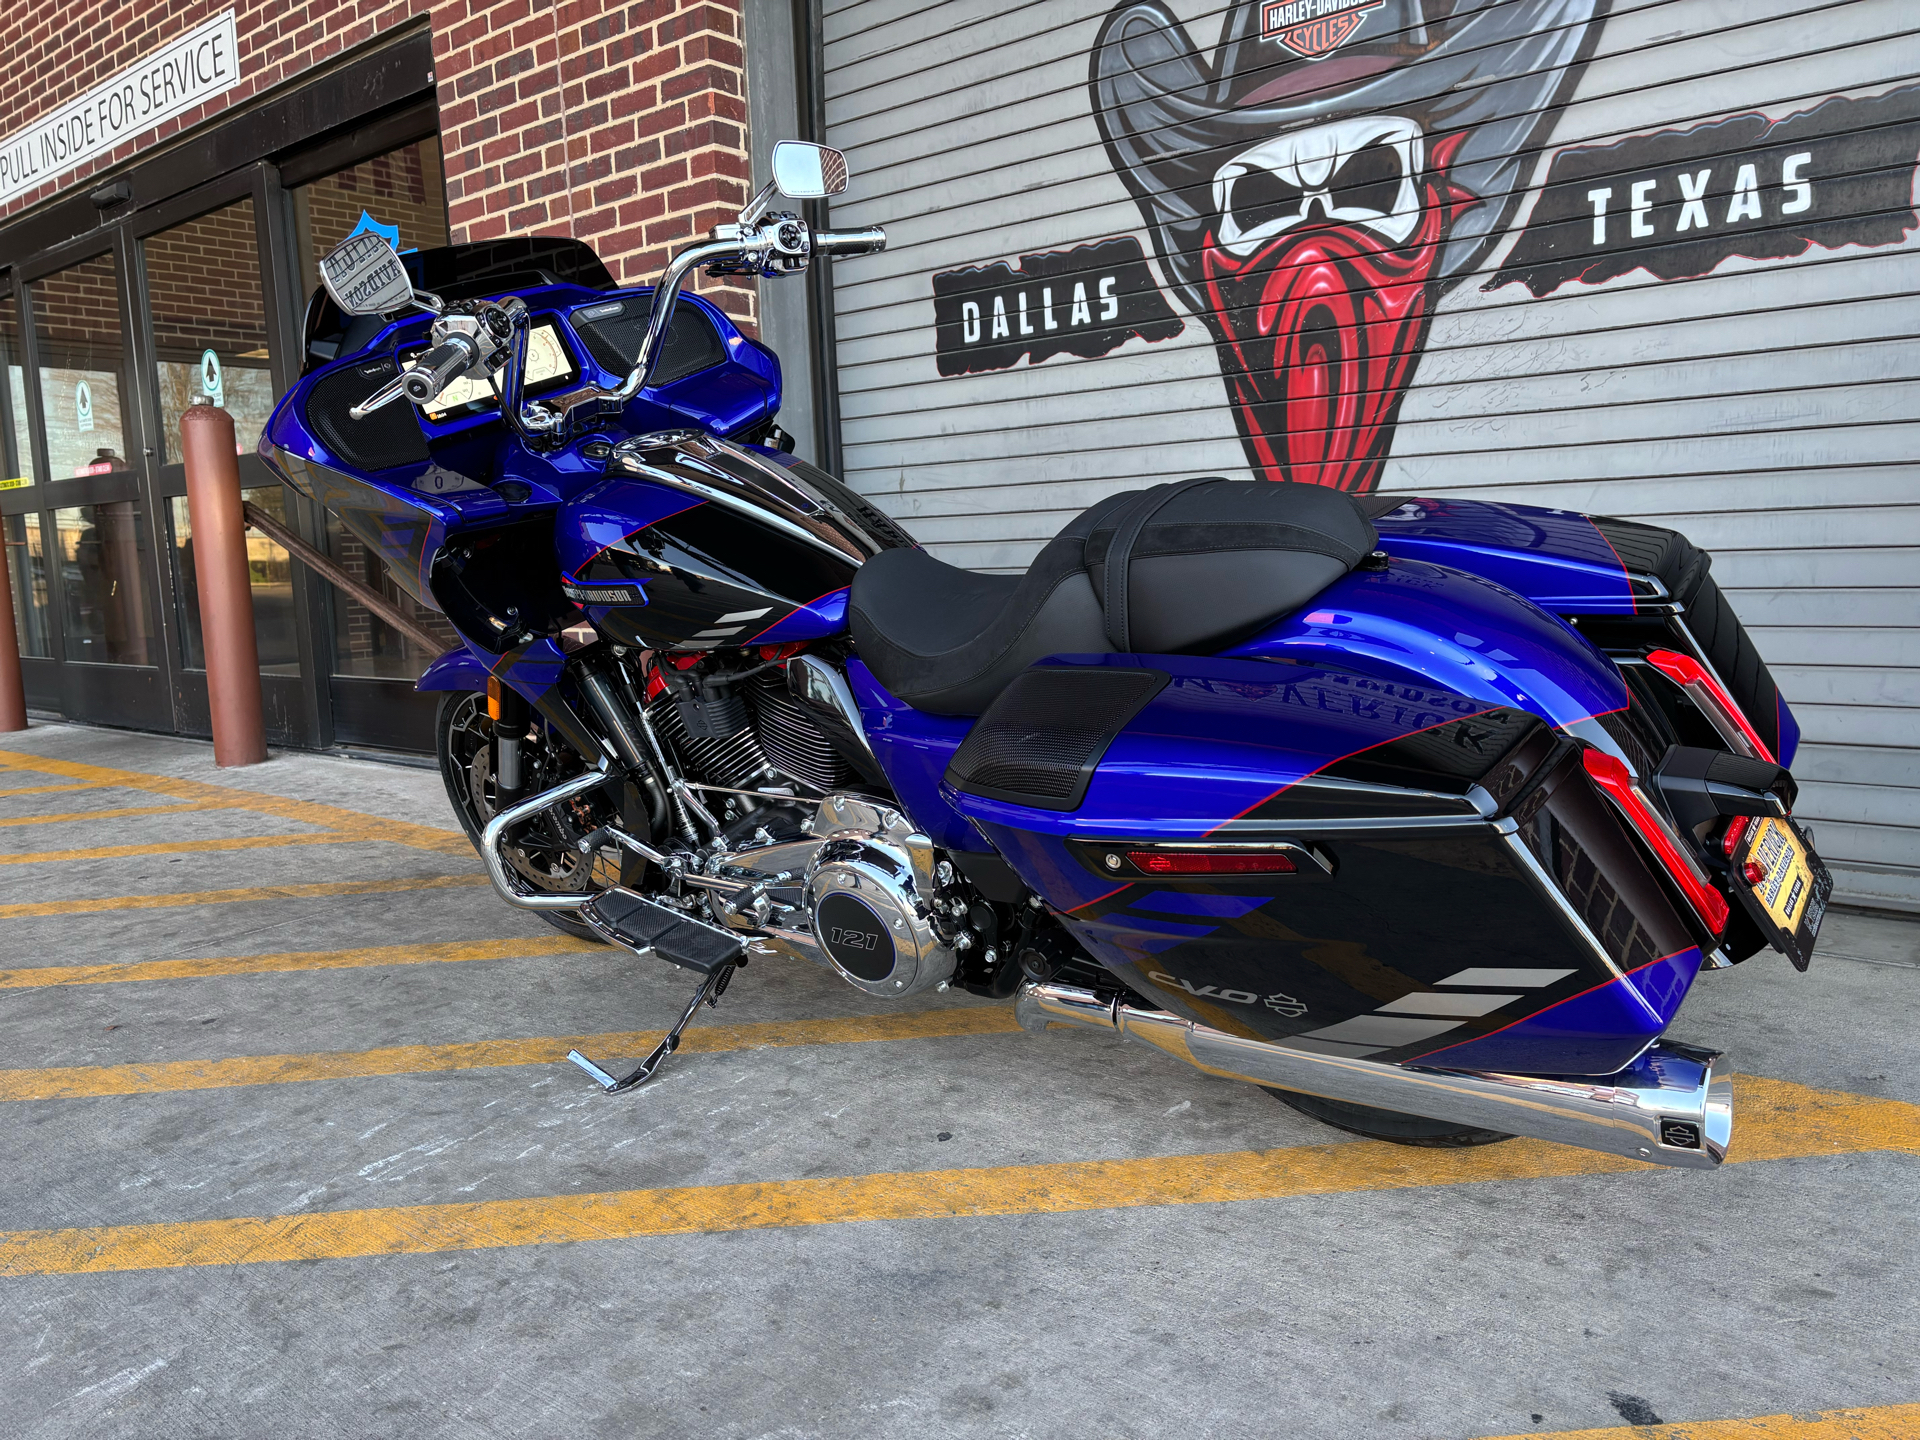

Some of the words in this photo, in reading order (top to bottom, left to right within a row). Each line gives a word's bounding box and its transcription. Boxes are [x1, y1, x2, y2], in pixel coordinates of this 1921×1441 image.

[1293, 15, 1349, 51] CYCLES
[0, 141, 38, 190] PULL
[39, 106, 96, 169] INSIDE
[97, 84, 137, 138] FOR
[139, 33, 226, 116] SERVICE
[1587, 152, 1812, 245] TEXAS
[962, 276, 1119, 344] DALLAS
[831, 926, 879, 951] 121
[1147, 970, 1258, 1005] CVO
